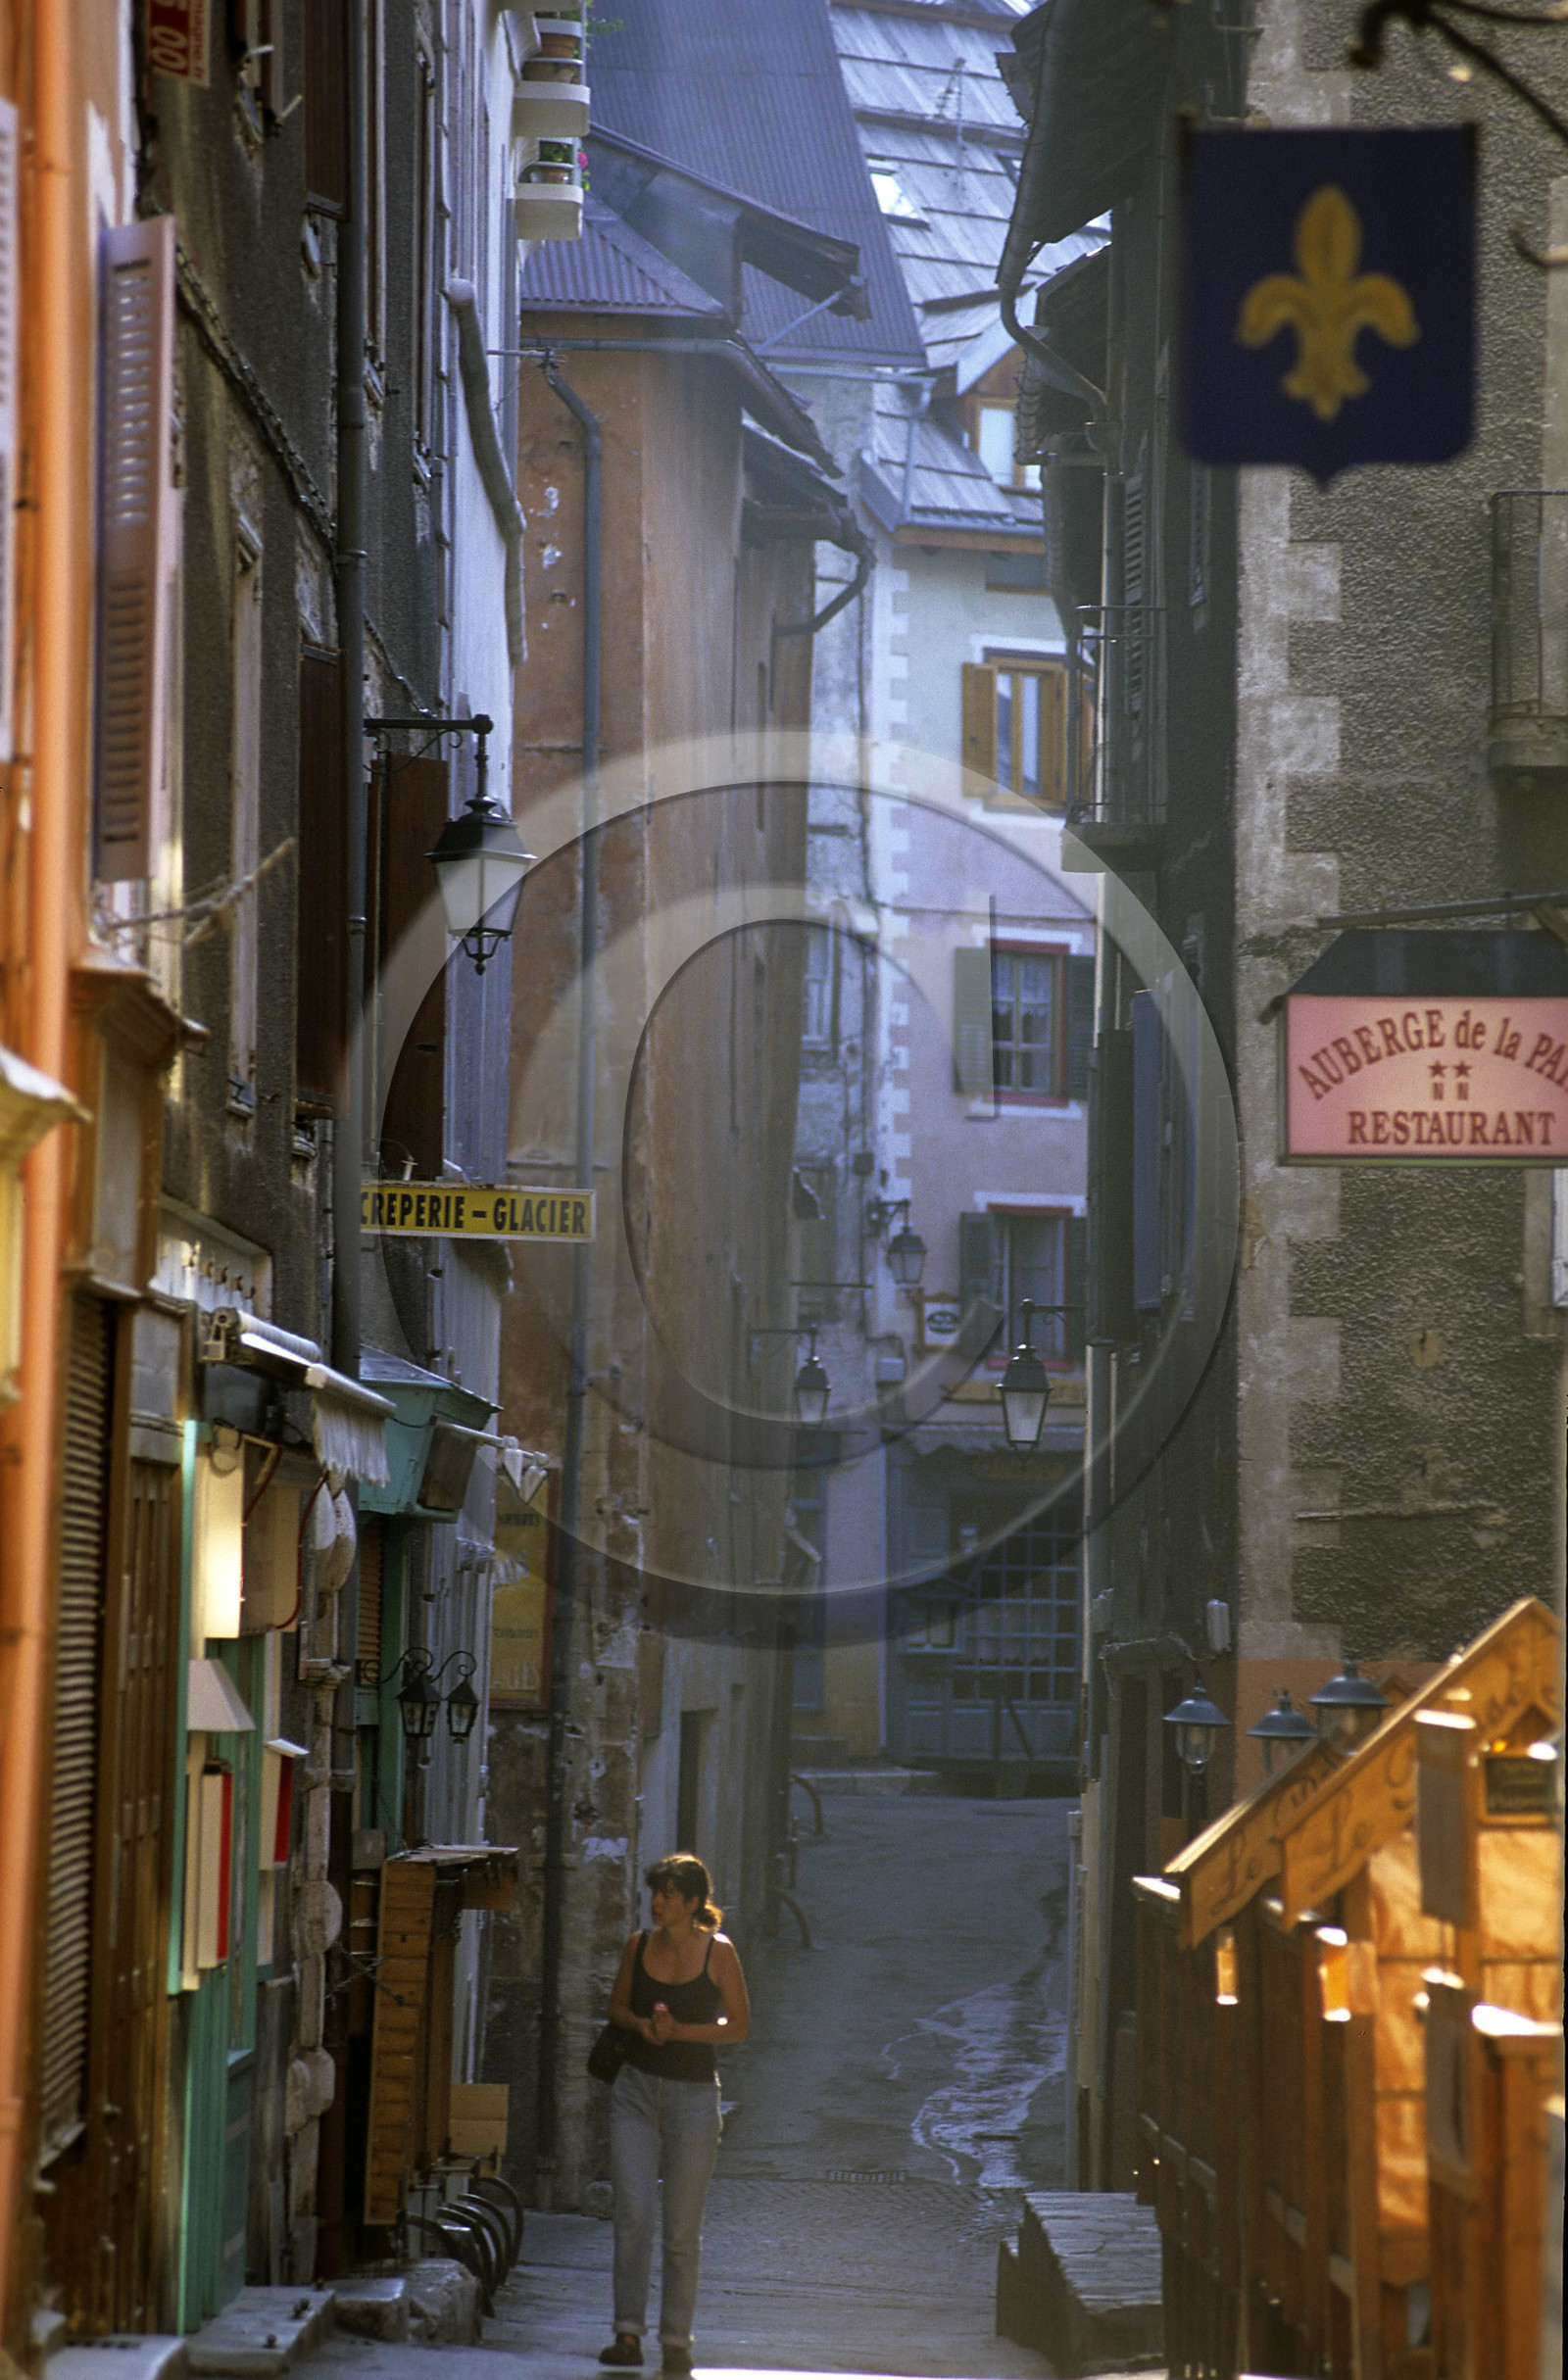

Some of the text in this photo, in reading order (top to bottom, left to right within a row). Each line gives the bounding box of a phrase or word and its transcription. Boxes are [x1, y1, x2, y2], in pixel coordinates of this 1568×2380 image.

[1298, 1009, 1568, 1101] AUBERGE de la PA
[1348, 1110, 1556, 1146] RESTAURANT
[361, 1190, 466, 1230] CREPERIE
[493, 1196, 587, 1234] GLACIER
